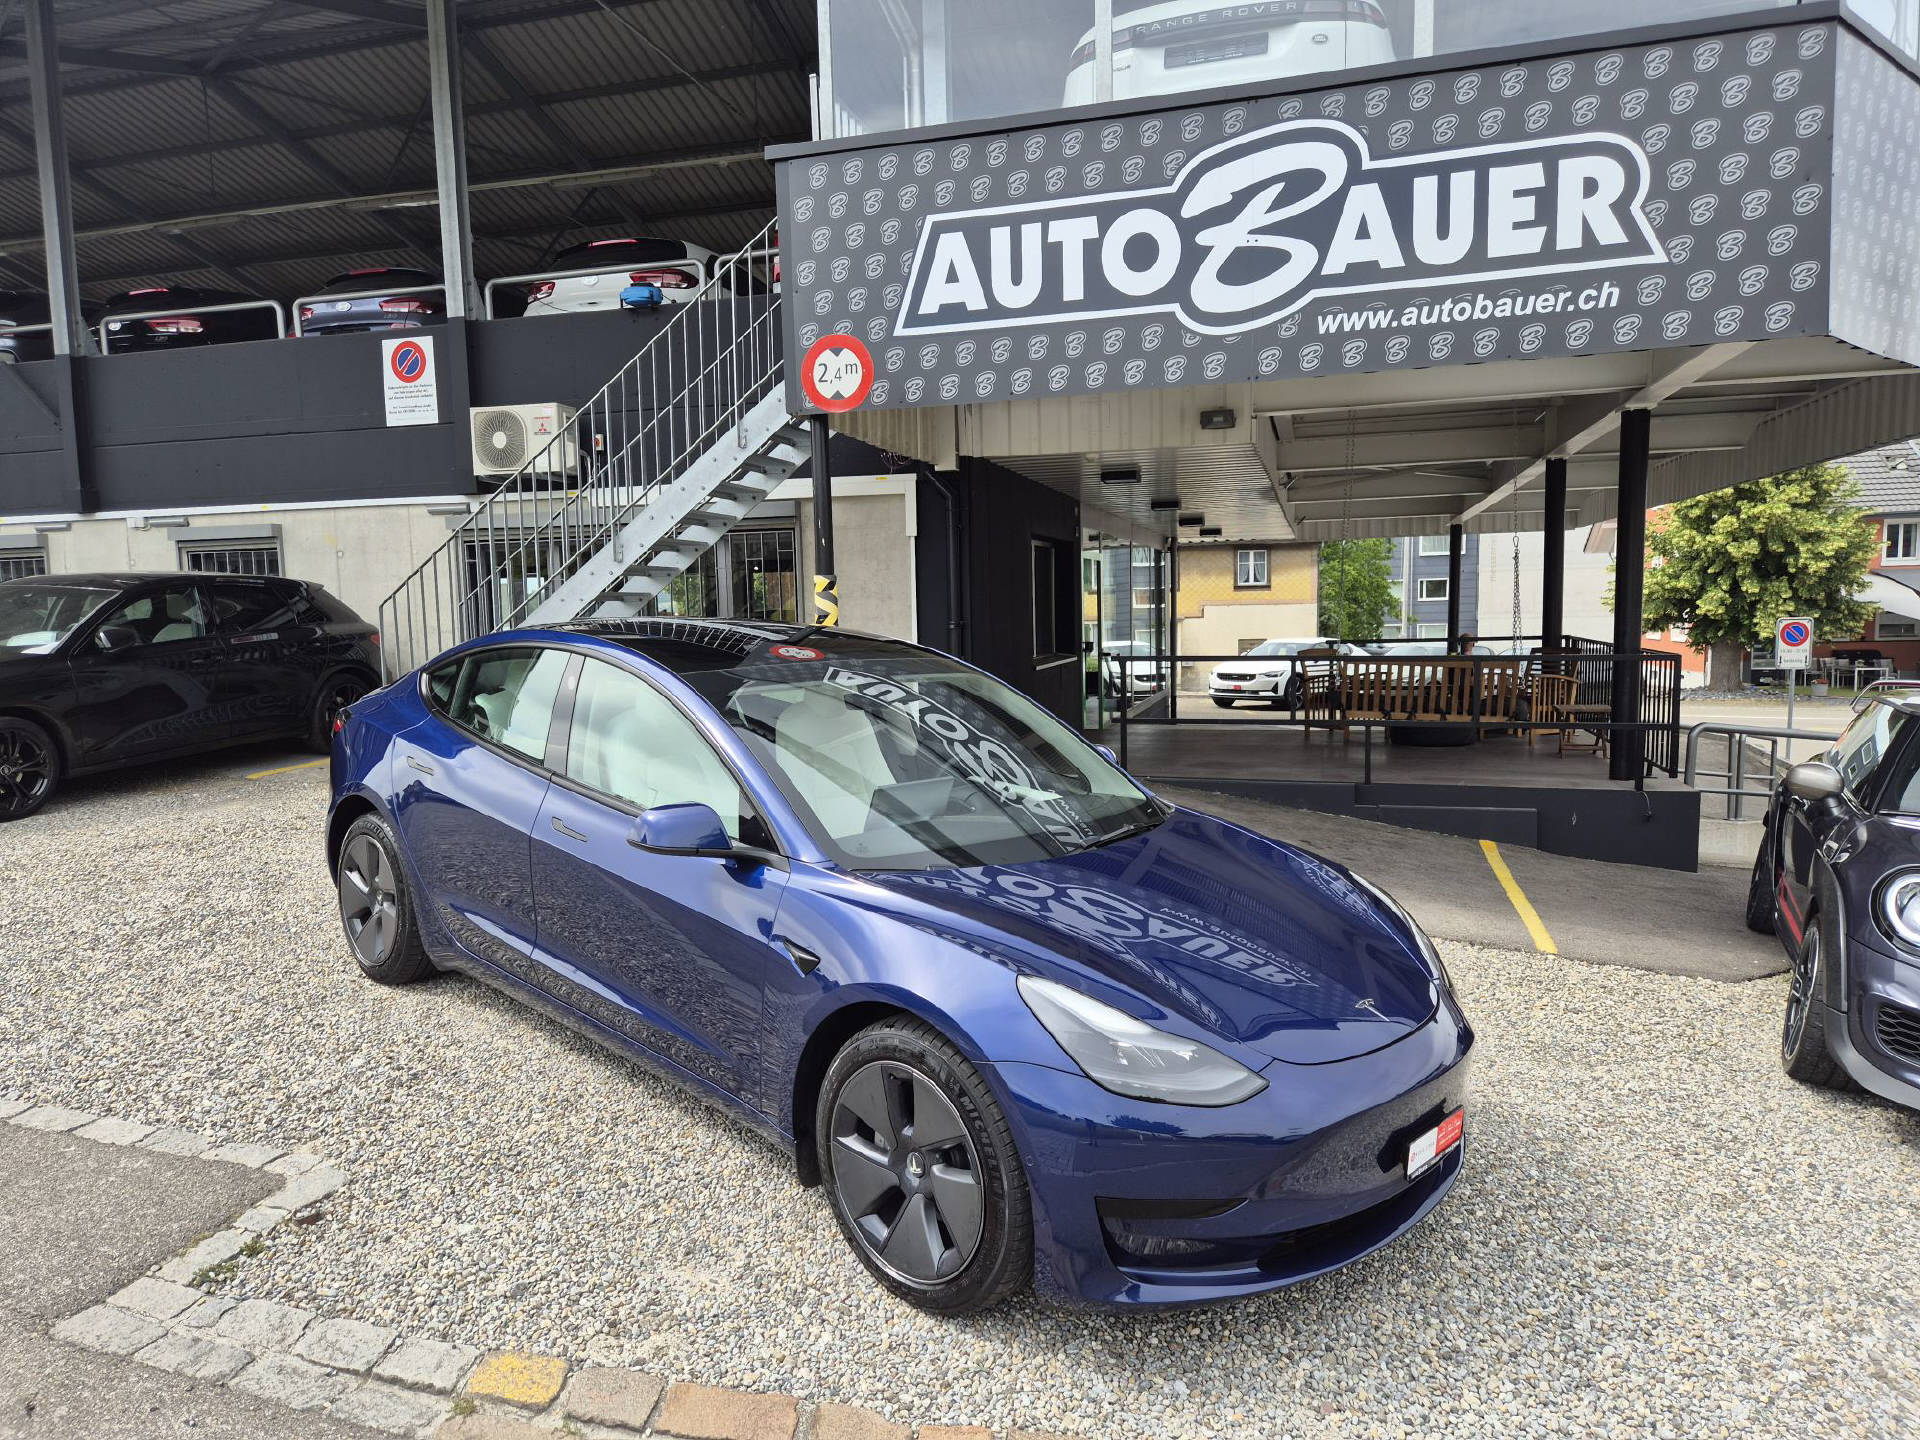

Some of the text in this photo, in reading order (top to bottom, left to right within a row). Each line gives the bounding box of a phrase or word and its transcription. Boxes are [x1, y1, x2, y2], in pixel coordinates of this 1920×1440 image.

[1136, 1, 1297, 34] RANGE ROVER
[1315, 281, 1620, 335] www.autobauer.ch
